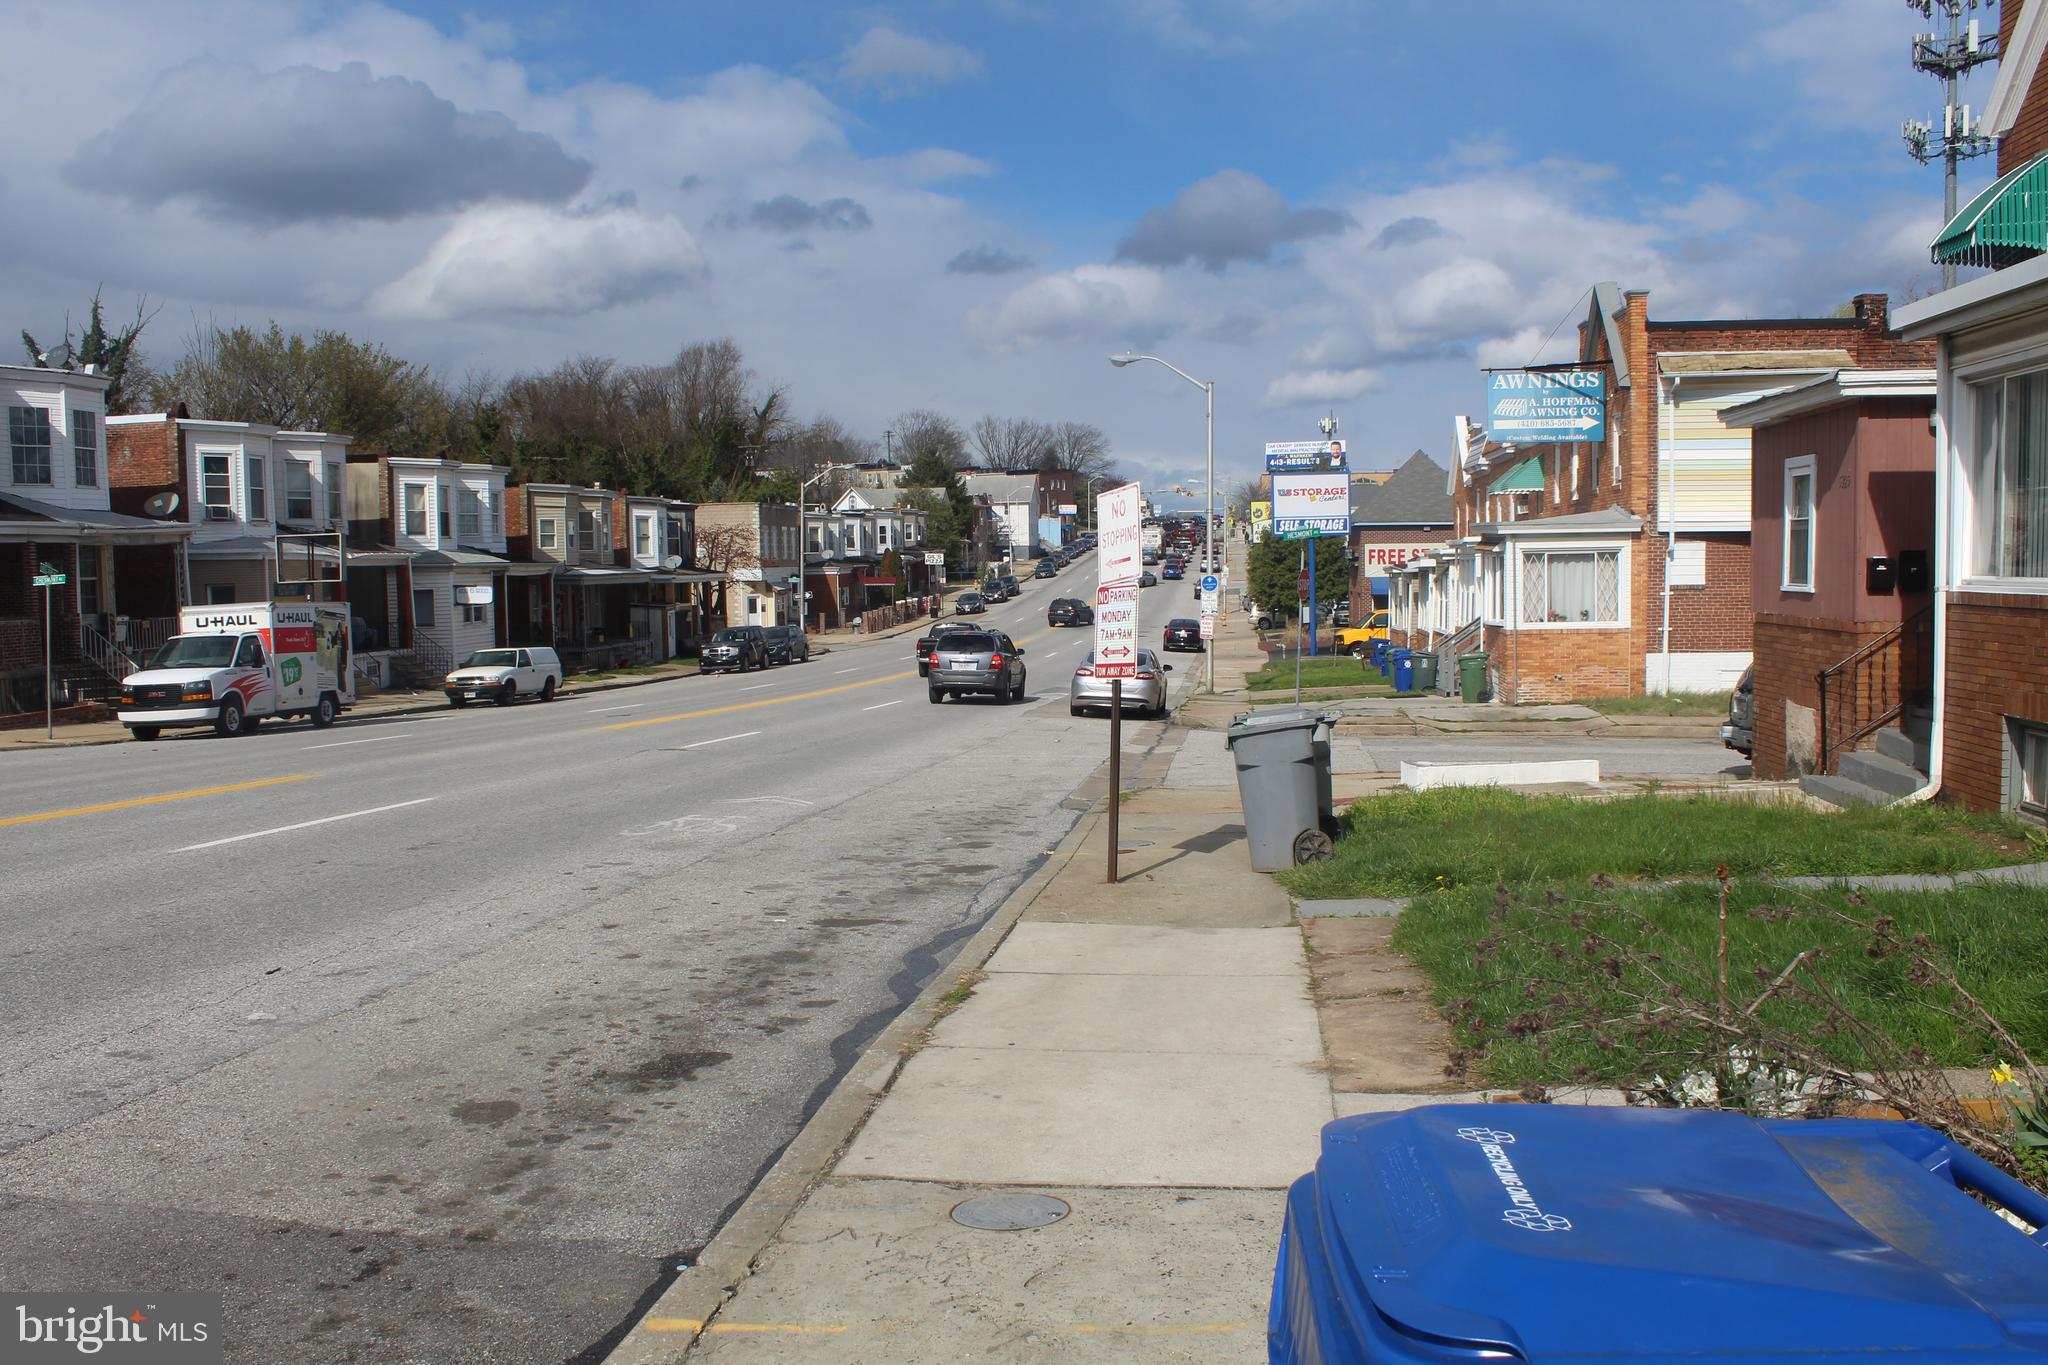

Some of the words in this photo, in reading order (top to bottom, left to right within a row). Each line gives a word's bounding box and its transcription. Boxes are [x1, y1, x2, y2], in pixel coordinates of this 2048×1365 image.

[1492, 371, 1600, 389] AWNINGS
[1528, 398, 1540, 406] A.
[1543, 396, 1600, 407] HOFFMAN
[1529, 408, 1577, 417] AWNING
[1581, 407, 1600, 416] CO.
[1293, 487, 1347, 496] STORAGE
[1111, 500, 1126, 519] NO
[1279, 520, 1300, 532] SELF
[1302, 518, 1345, 531] STORAGE
[1102, 524, 1138, 549] STOPPING
[1368, 549, 1406, 565] FREE
[1098, 590, 1109, 604] NO
[1110, 589, 1137, 603] PARKING
[196, 614, 258, 628] U-HAUL
[277, 612, 313, 624] U-HAUL
[1101, 610, 1132, 623] MONDAY
[1100, 627, 1133, 640] 7AM-9AM
[1096, 667, 1106, 676] TOW
[1106, 666, 1121, 676] AWAY
[1121, 666, 1135, 676] ZONE
[1480, 1143, 1524, 1186] RECYCLING
[1505, 1186, 1538, 1211] ONLY
